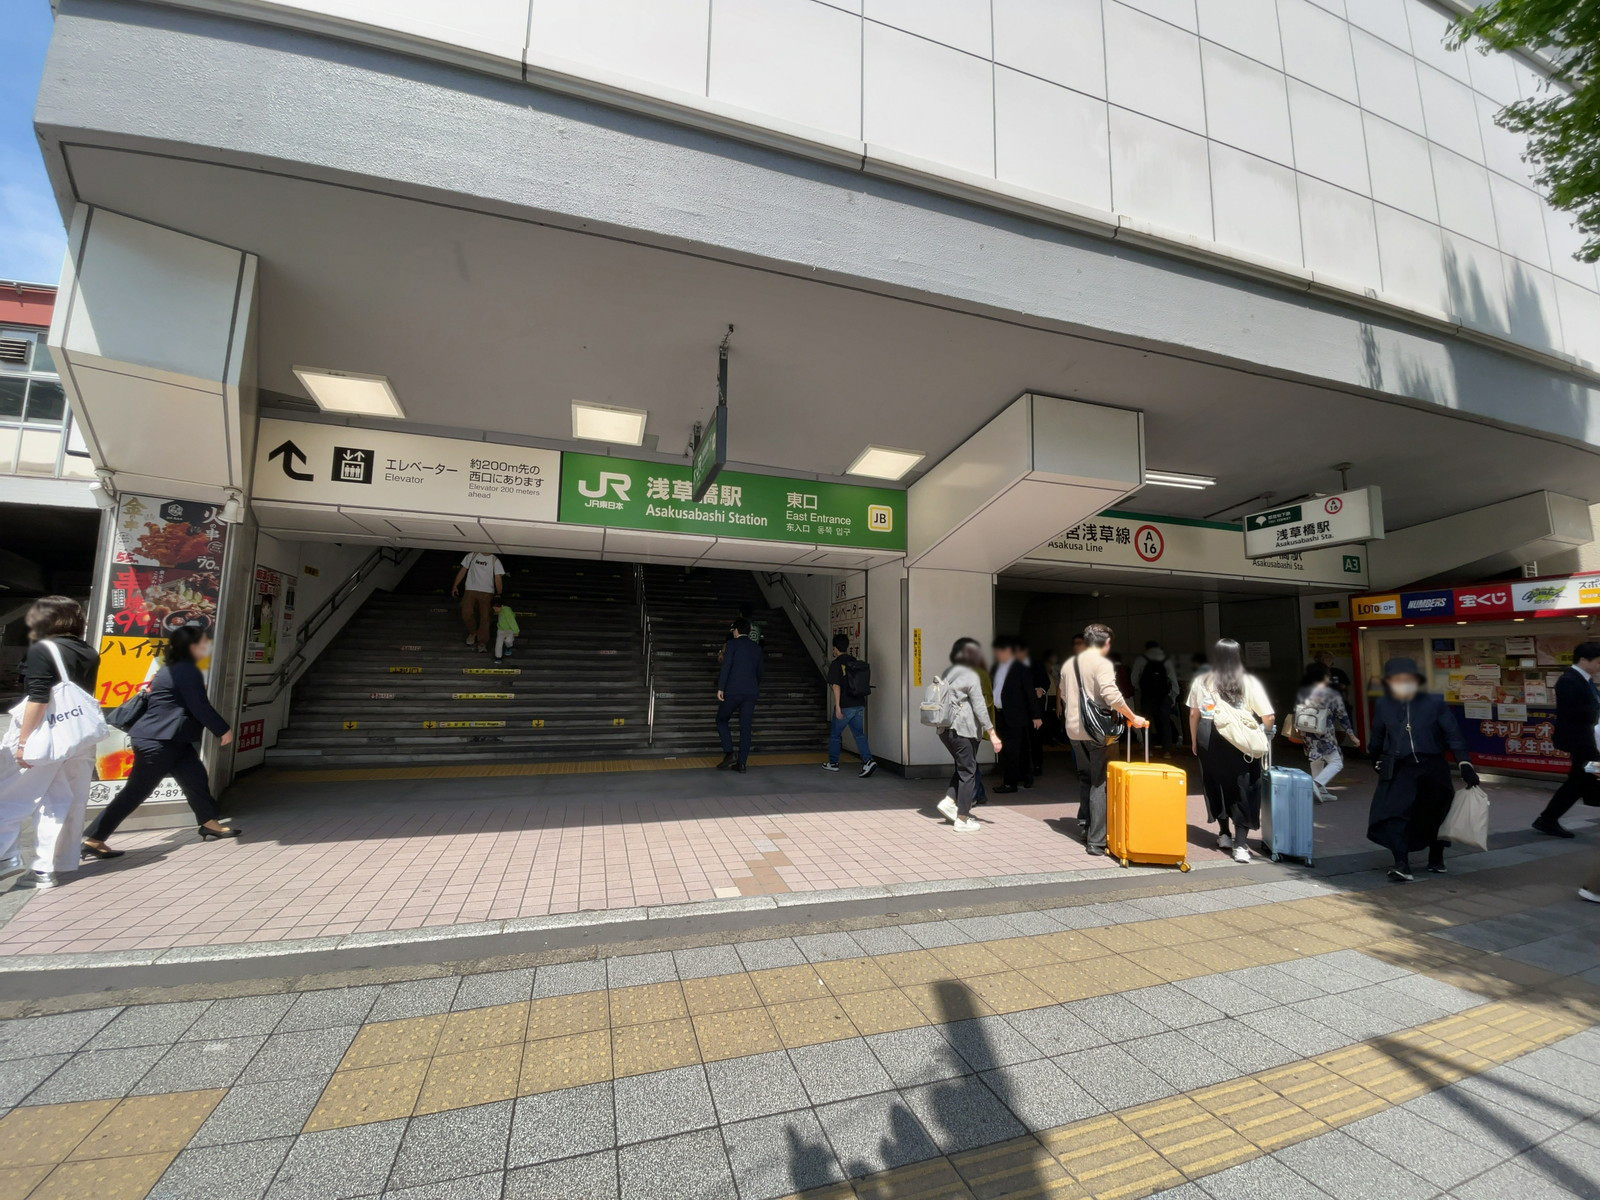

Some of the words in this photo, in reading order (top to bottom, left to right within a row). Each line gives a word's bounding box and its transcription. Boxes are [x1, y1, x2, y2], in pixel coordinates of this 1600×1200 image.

[385, 459, 458, 474] エレベーター
[470, 458, 540, 475] 約200m先の
[385, 473, 424, 485] Elevator
[469, 471, 544, 488] 西口にあります
[578, 471, 632, 501] JR
[468, 491, 491, 499] ahead
[469, 483, 498, 493] Elevator
[500, 486, 514, 494] 200
[515, 487, 540, 496] meters
[646, 475, 742, 508] 浅草橋駅
[584, 499, 624, 511] JR東日本
[786, 492, 818, 510] 東口
[645, 504, 725, 523] Asakusabashi
[728, 511, 768, 527] Station
[786, 510, 808, 522] East
[810, 512, 852, 526] Entrance
[873, 512, 887, 524] JB
[786, 523, 810, 533] 东入口
[835, 526, 851, 536] 입구
[1059, 523, 1131, 545] 営浅草線
[1276, 520, 1331, 541] 浅草橋駅
[1145, 532, 1153, 541] A
[1275, 535, 1320, 548] Asakusabashi
[1048, 541, 1083, 551] Asakusa
[1085, 543, 1104, 553] Line
[1143, 542, 1157, 554] 16
[1252, 559, 1292, 569] Asakusabashi
[1293, 562, 1305, 570] Sta.
[1345, 558, 1359, 572] A3
[1579, 578, 1600, 590] スポ
[836, 584, 846, 599] JR
[1407, 598, 1447, 609] NUMBERS
[1458, 592, 1507, 608] 宝くじ
[832, 604, 863, 619] エレベーター
[1358, 603, 1380, 615] LOTO
[47, 705, 83, 726] Merci
[1481, 721, 1553, 738] キャリーオ
[1507, 740, 1570, 757] 発生中
